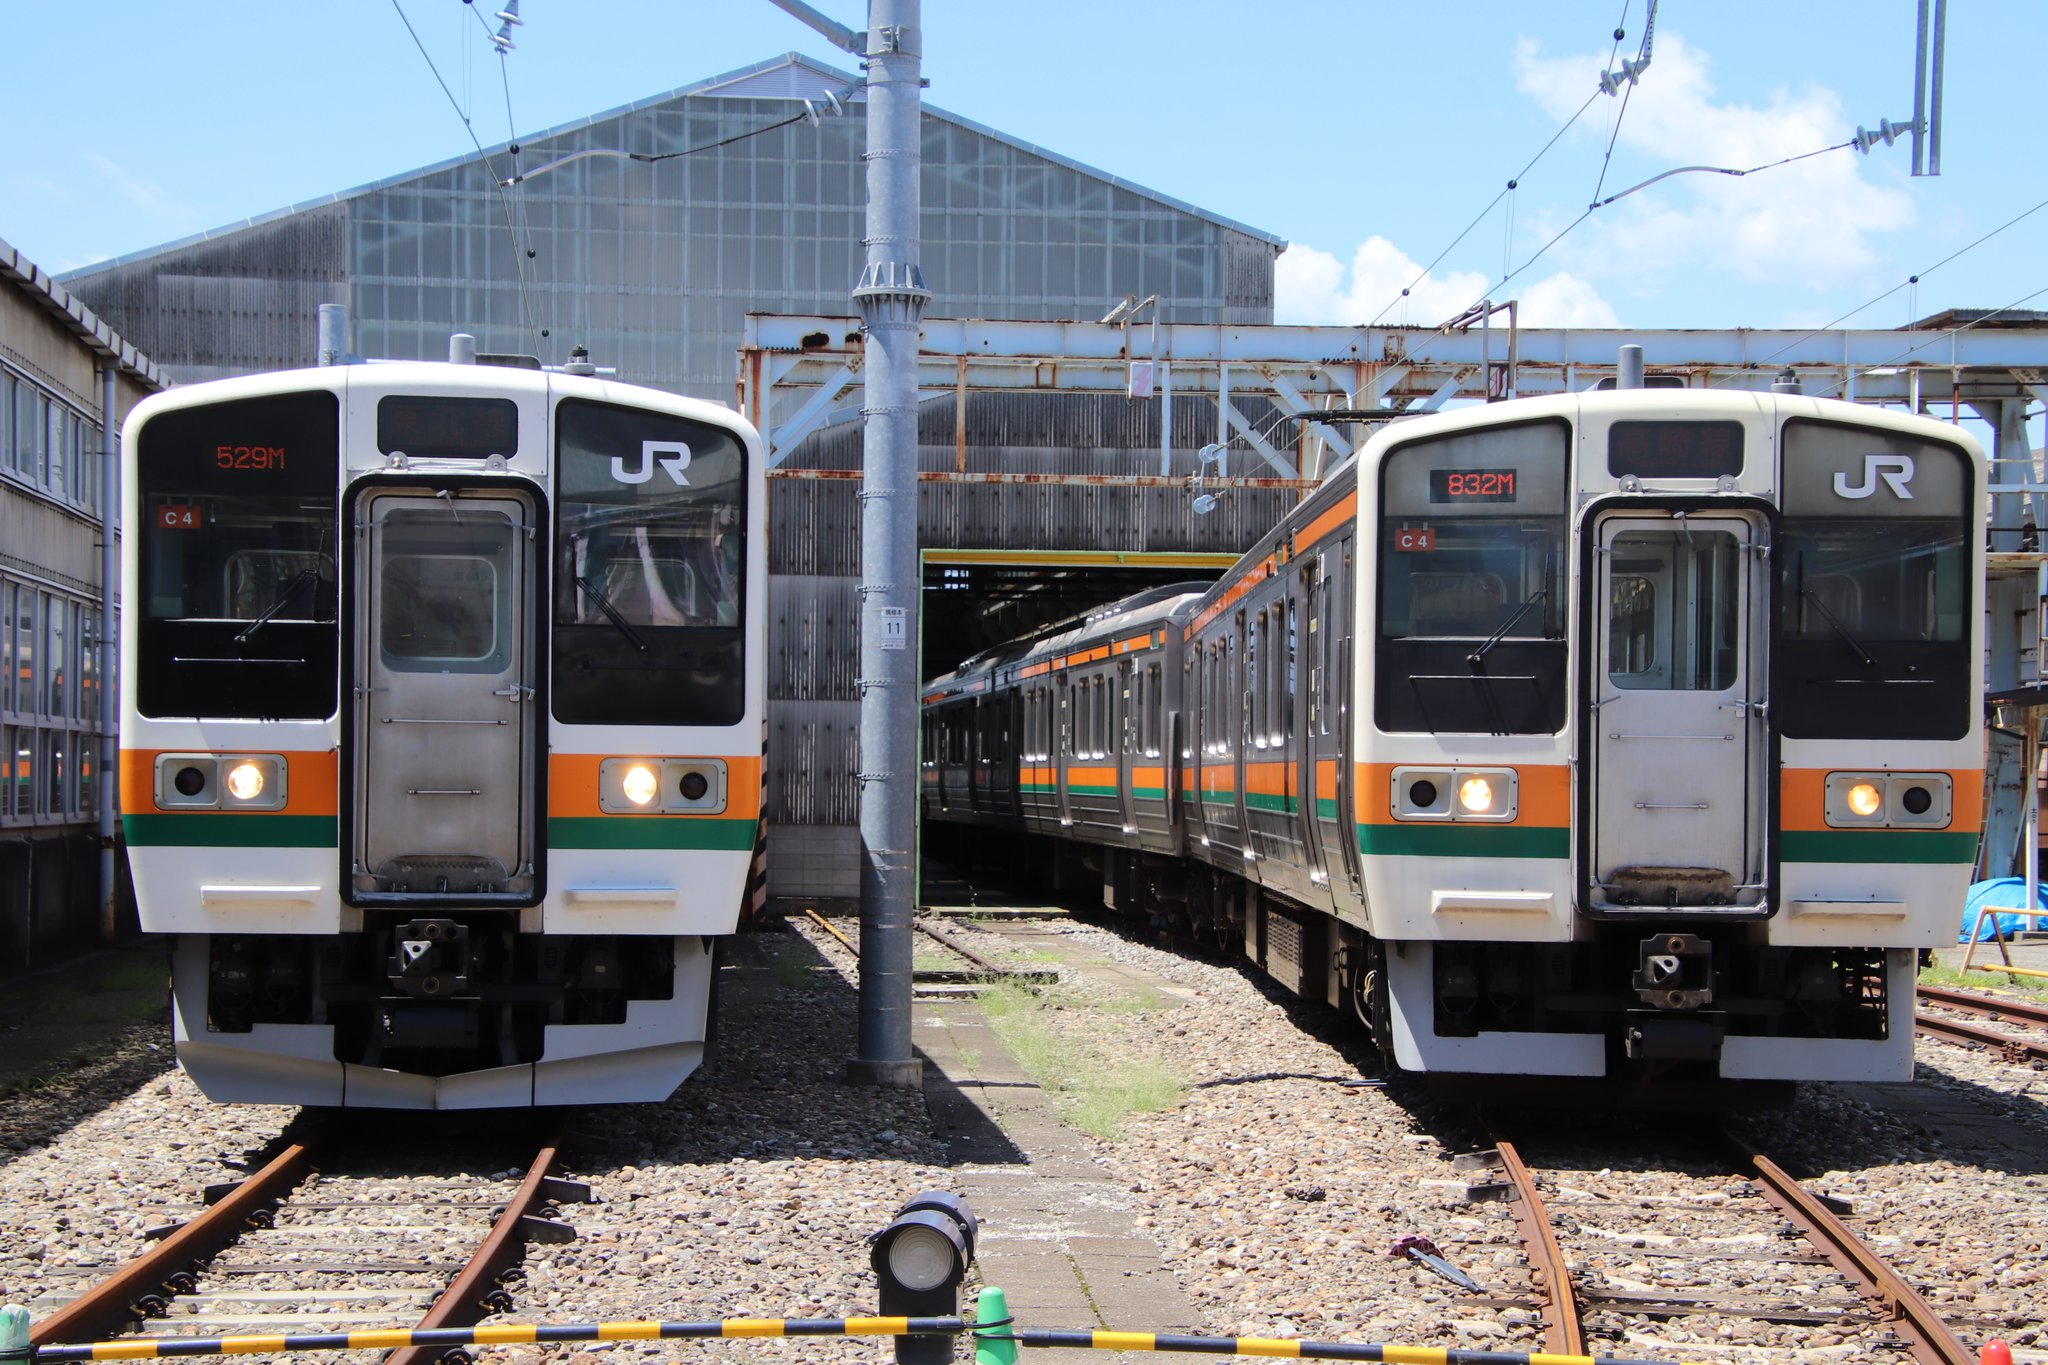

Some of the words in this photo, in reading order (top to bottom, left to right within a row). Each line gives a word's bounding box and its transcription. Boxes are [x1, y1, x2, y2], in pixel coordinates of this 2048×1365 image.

[217, 446, 285, 469] 529M
[611, 440, 691, 486] JR
[1448, 474, 1514, 495] 832M
[1833, 455, 1914, 499] JR
[887, 622, 900, 634] 11
